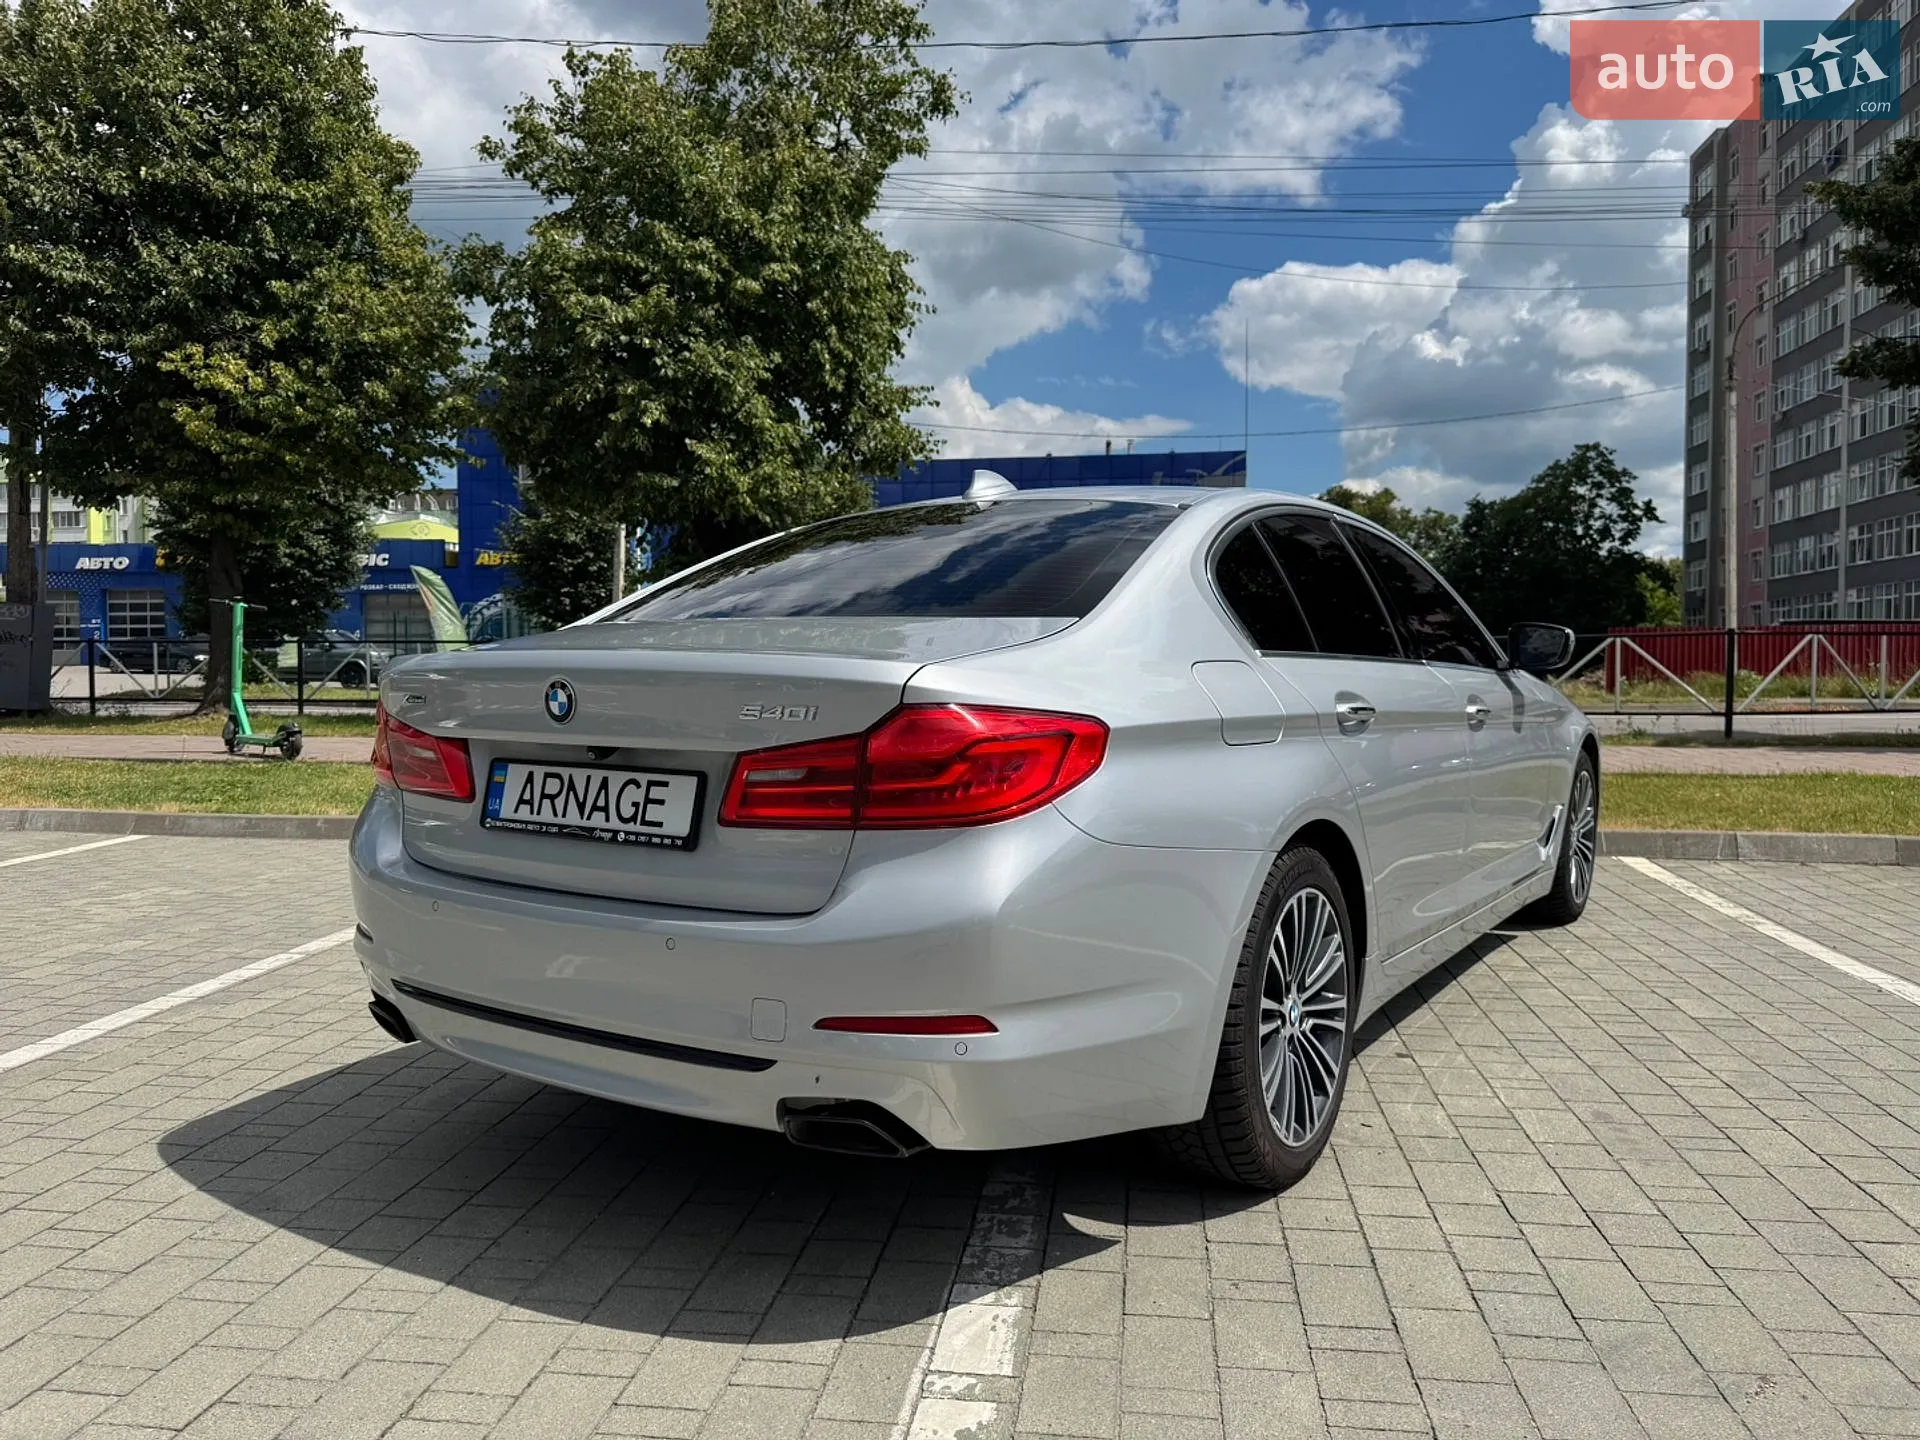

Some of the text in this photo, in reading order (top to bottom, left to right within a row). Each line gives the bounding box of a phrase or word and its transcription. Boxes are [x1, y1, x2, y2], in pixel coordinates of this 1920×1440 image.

[75, 556, 130, 570] АВТО
[738, 703, 820, 722] 540i
[488, 798, 500, 810] UA
[514, 770, 670, 828] ARNAGE
